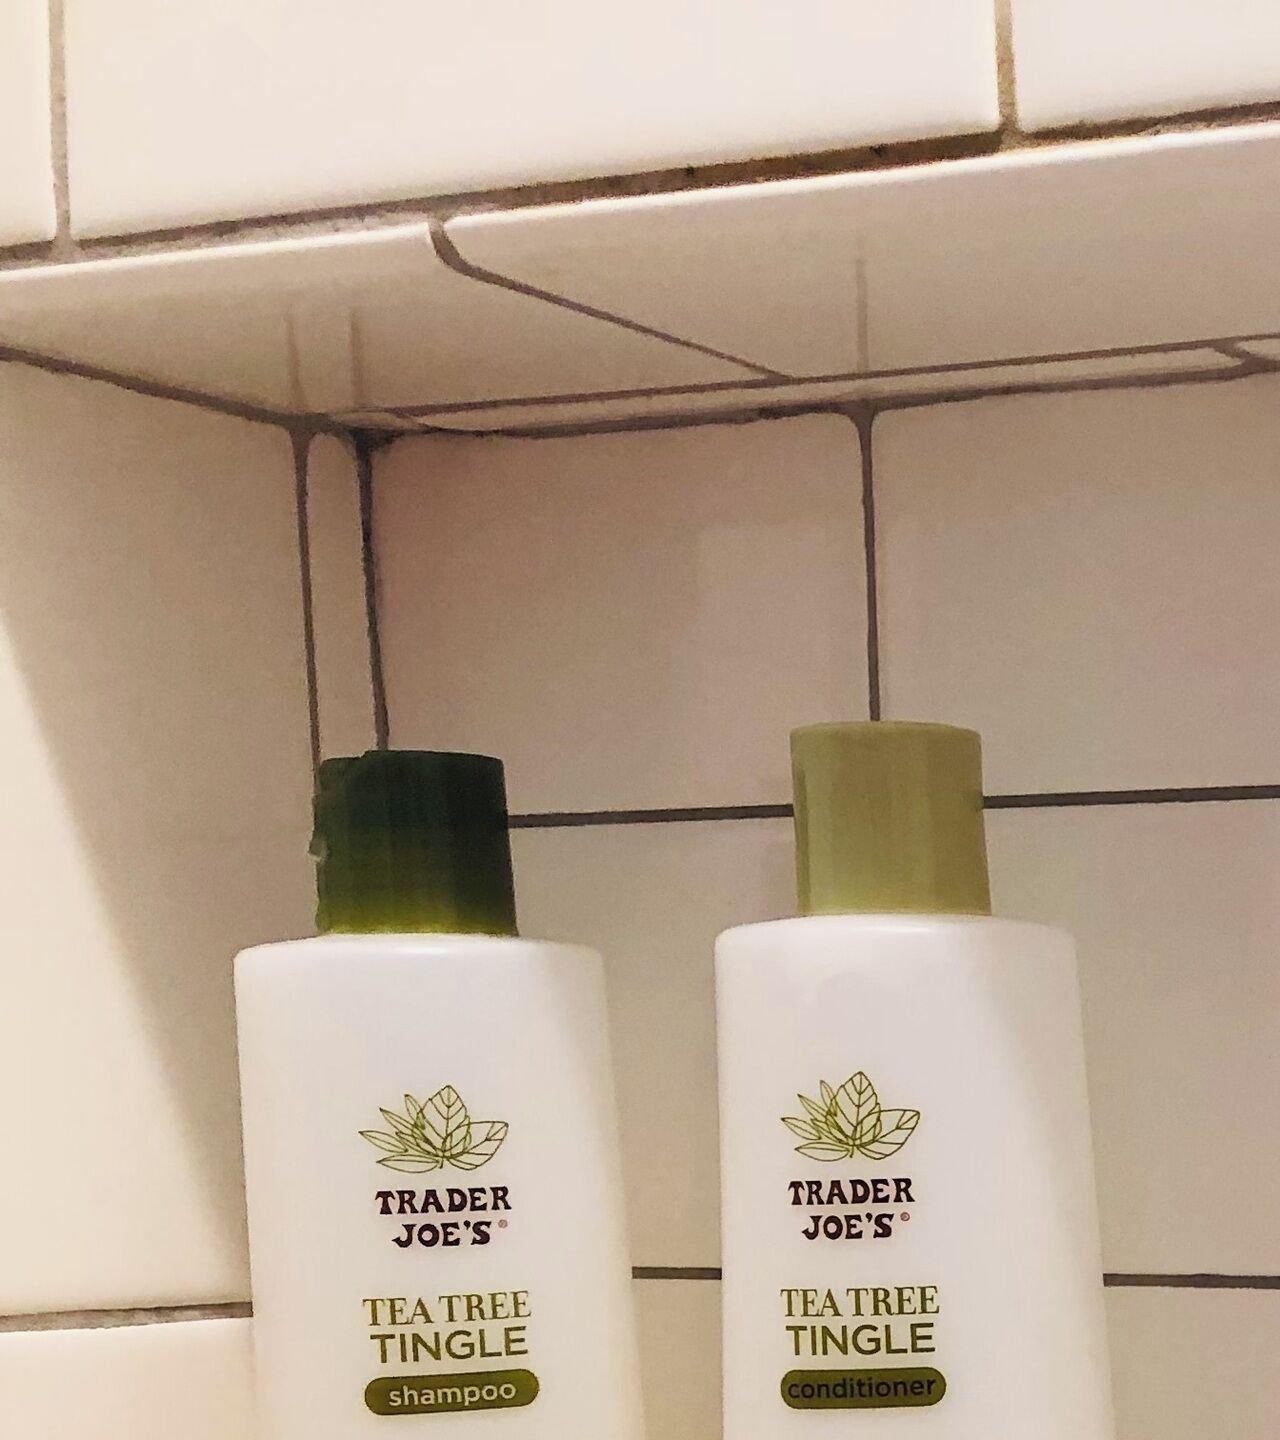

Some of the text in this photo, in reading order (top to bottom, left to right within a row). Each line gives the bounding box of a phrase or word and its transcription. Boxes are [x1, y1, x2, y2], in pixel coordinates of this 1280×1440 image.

[375, 1186, 512, 1215] TRADER
[788, 1178, 916, 1206] TRADER
[363, 1290, 532, 1326] TEA TREE
[780, 1286, 940, 1317] TEA TREE
[370, 1326, 528, 1363] TINGLE
[786, 1323, 936, 1356] TINGLE
[389, 1383, 517, 1408] shampoo
[787, 1377, 936, 1399] conditioner
